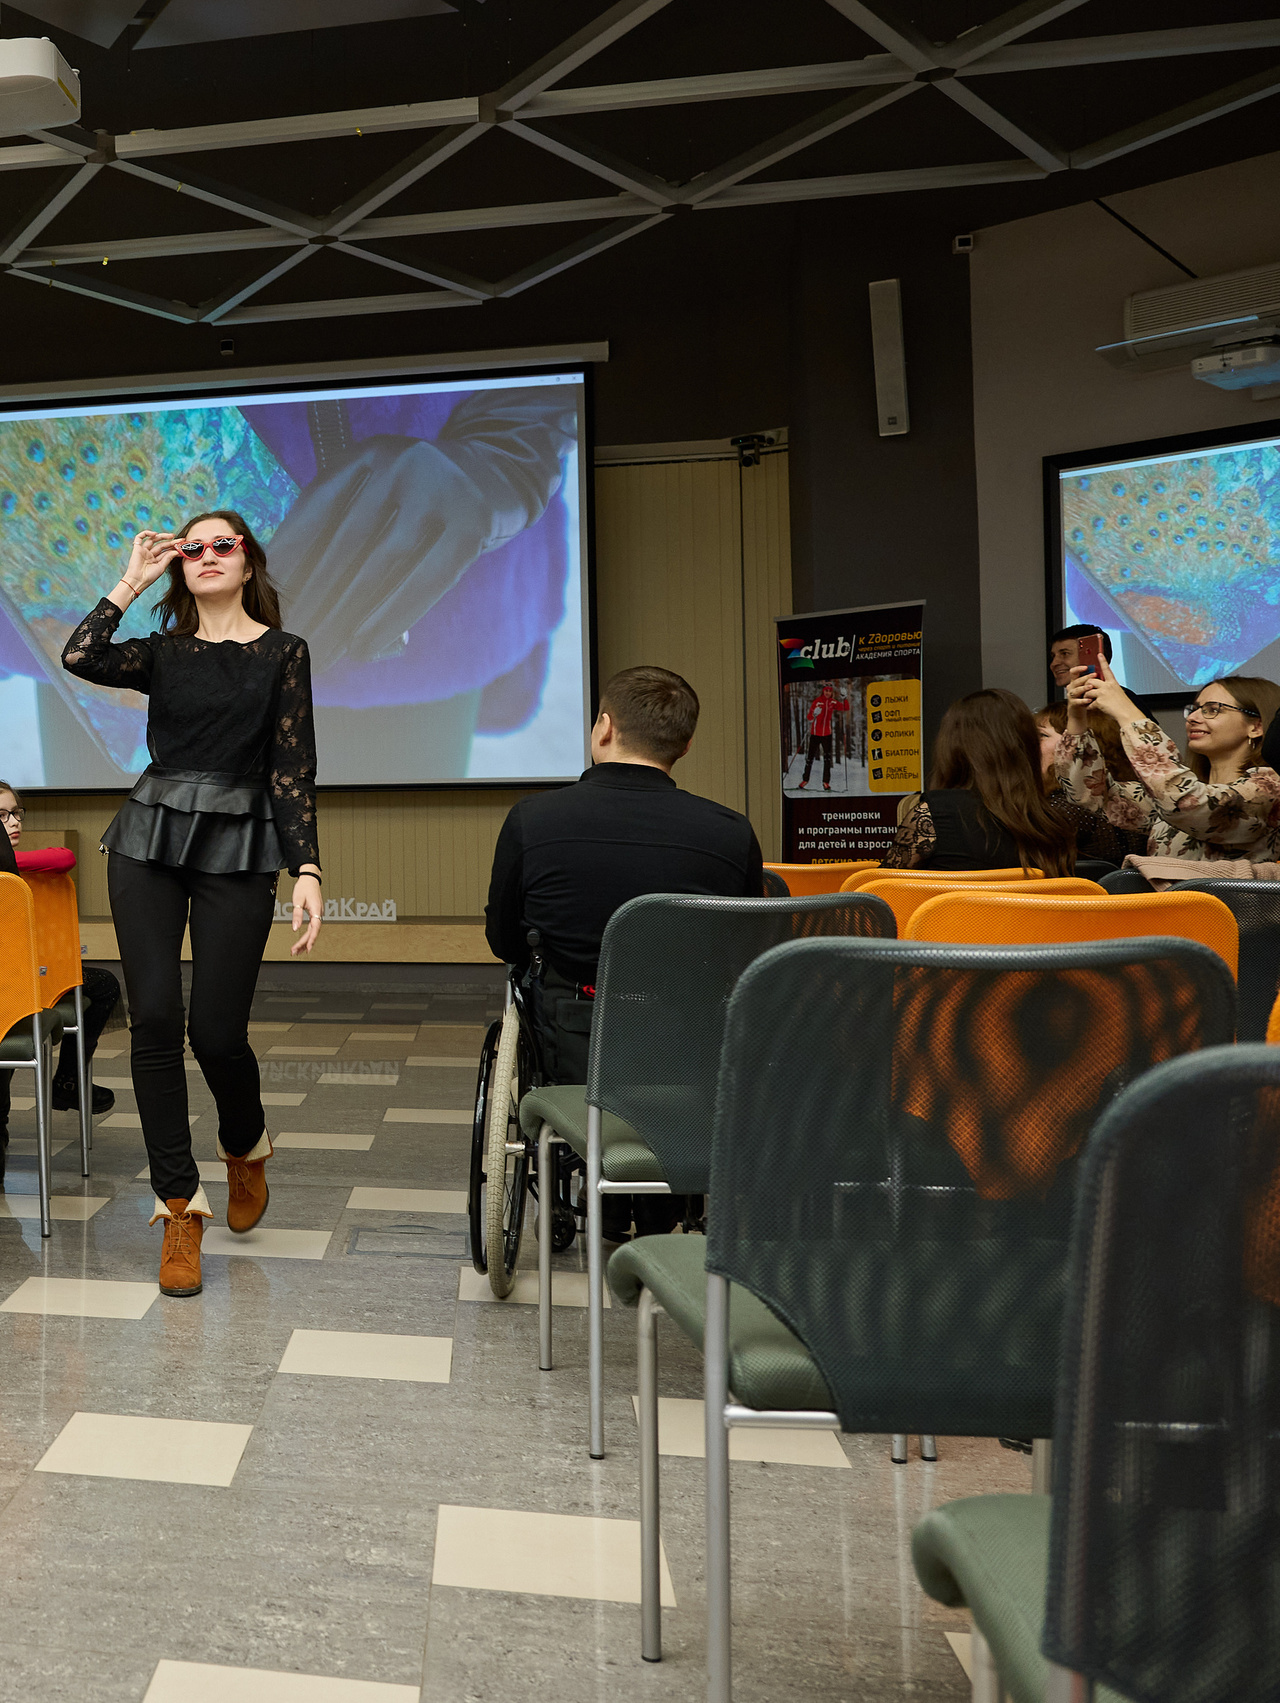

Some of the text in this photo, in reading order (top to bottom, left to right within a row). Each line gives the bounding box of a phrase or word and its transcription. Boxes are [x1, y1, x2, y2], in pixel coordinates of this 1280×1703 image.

[800, 637, 850, 660] club
[856, 648, 920, 660] АКАДЕМИЯ СПОРТА
[886, 749, 919, 757] БИАТЛОН
[822, 812, 881, 822] тренировки
[807, 826, 862, 836] программы
[798, 841, 816, 850] для
[818, 839, 847, 850] детей
